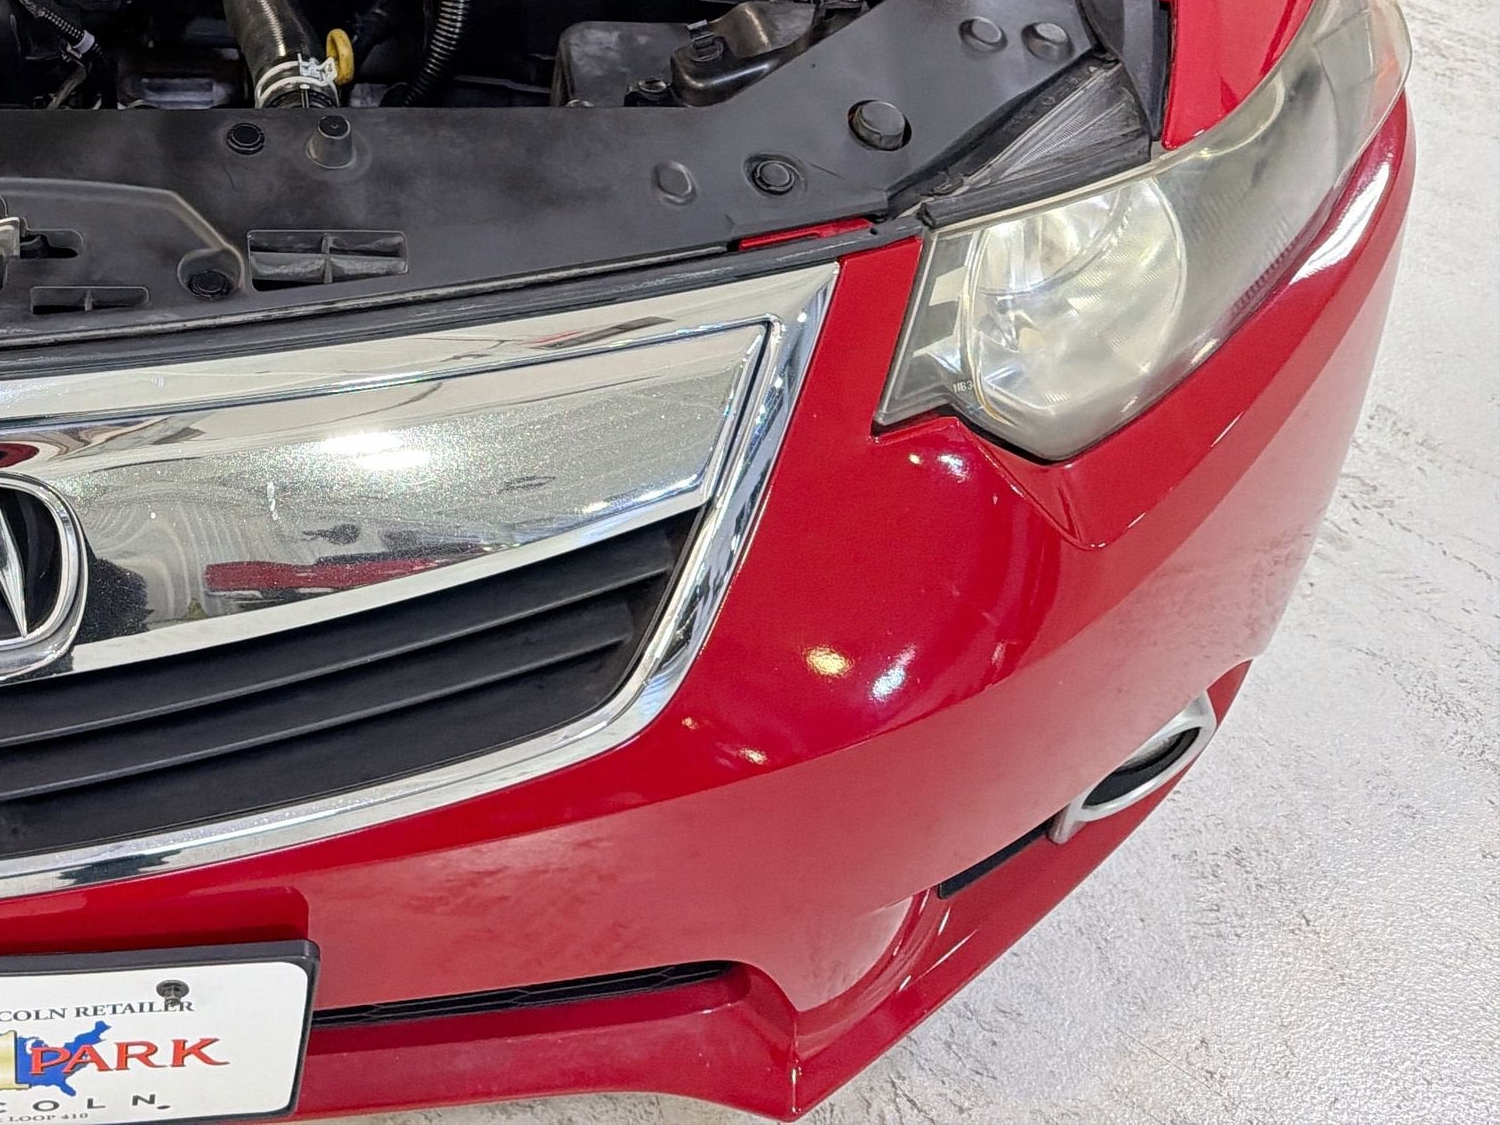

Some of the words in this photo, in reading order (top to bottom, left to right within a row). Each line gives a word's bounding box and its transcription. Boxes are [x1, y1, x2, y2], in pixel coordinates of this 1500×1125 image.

[74, 1000, 195, 1018] RETAILER
[29, 1037, 231, 1076] PARK
[8, 1114, 57, 1123] LOOP
[61, 1112, 88, 1121] 410
